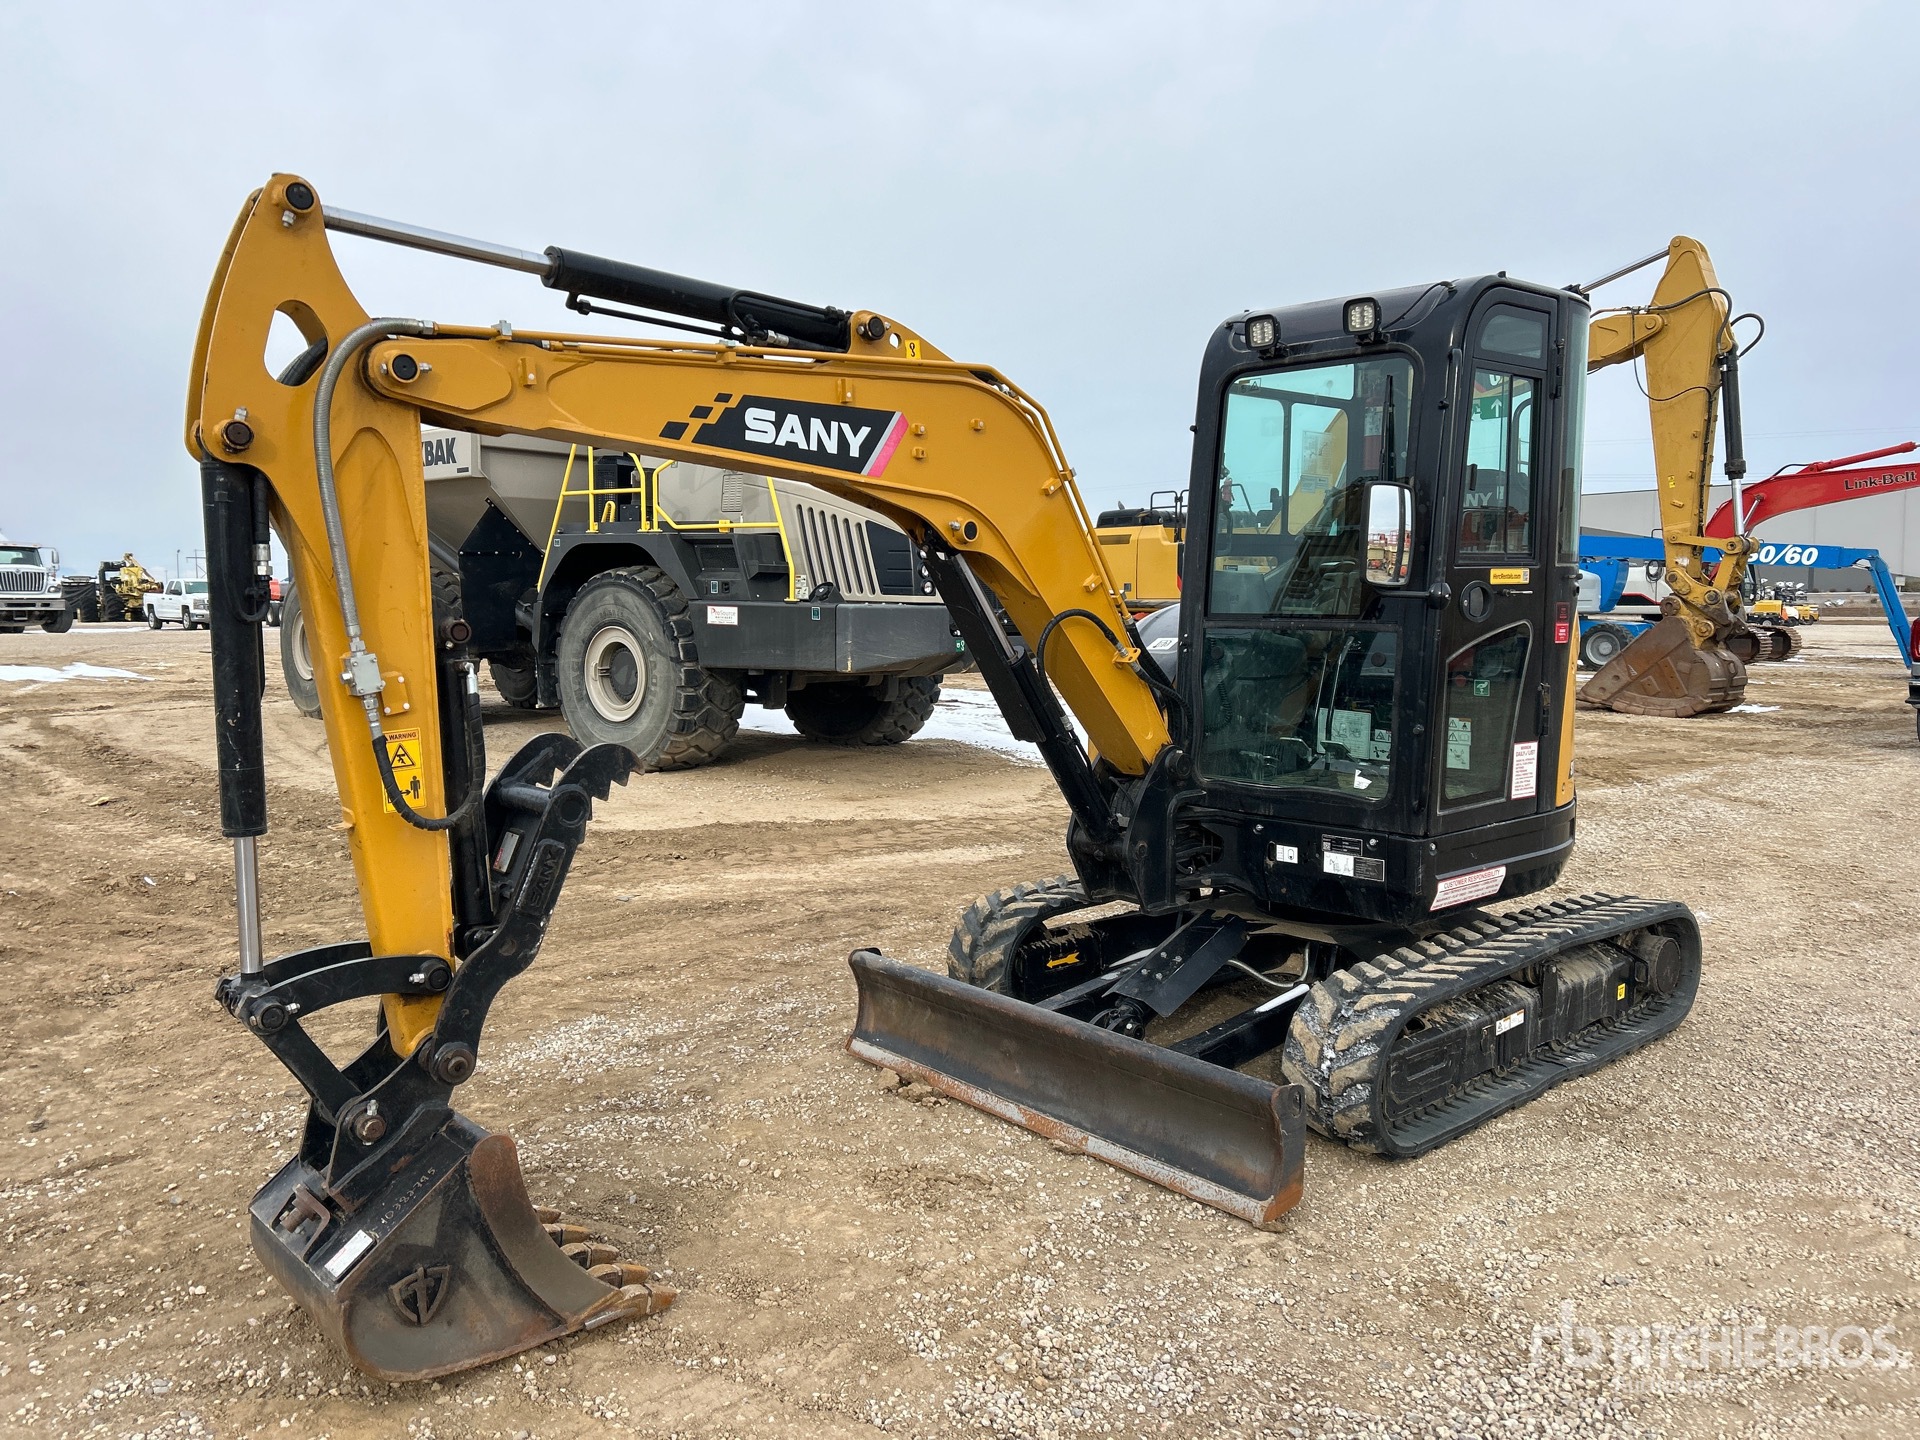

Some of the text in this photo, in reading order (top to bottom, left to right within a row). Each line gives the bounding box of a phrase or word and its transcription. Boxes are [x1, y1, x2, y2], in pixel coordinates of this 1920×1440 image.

[744, 407, 872, 458] SANY
[422, 437, 457, 467] BAK
[1844, 470, 1917, 490] Link-Belt
[1463, 492, 1493, 507] NY
[388, 731, 417, 741] WARNING
[1443, 869, 1501, 890] CUSTOMER RESPONSIBILITY
